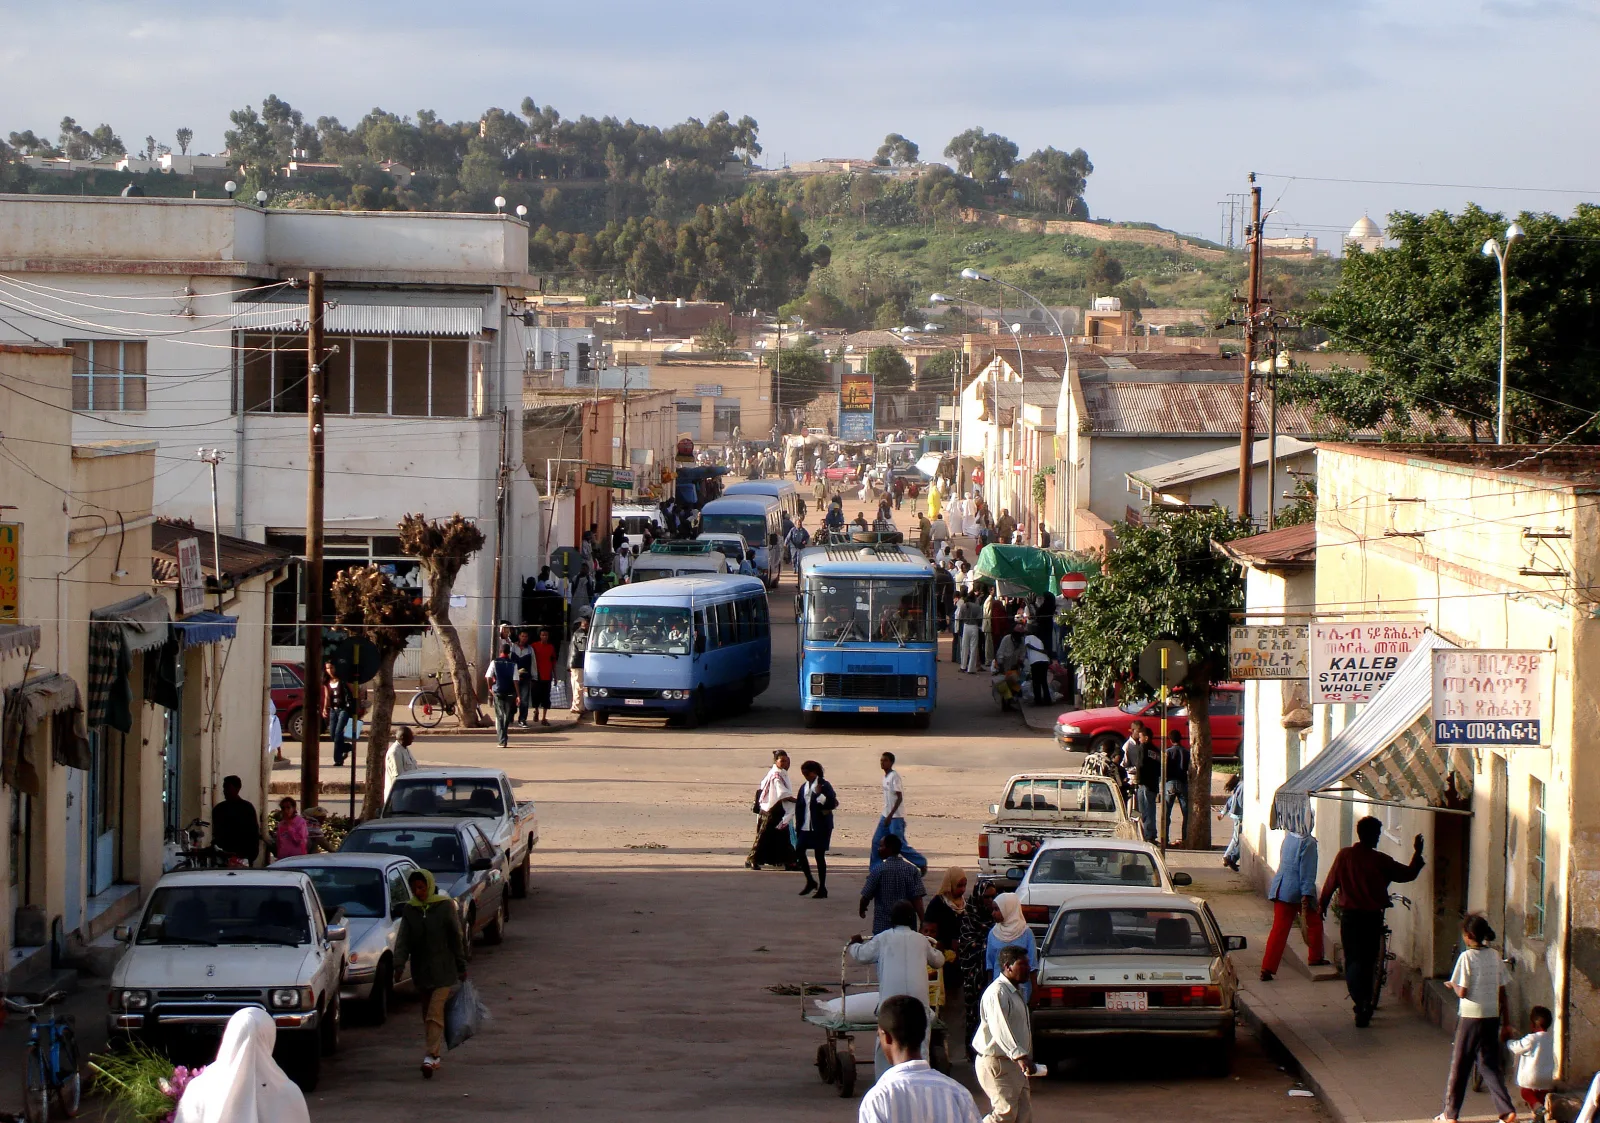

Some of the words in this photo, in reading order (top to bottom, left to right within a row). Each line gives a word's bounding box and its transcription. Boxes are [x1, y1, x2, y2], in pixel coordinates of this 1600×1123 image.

[1329, 657, 1398, 670] KALEB
[1318, 671, 1395, 683] STATIONE
[1320, 683, 1373, 692] WHOLE
[1438, 722, 1463, 739] ቤት
